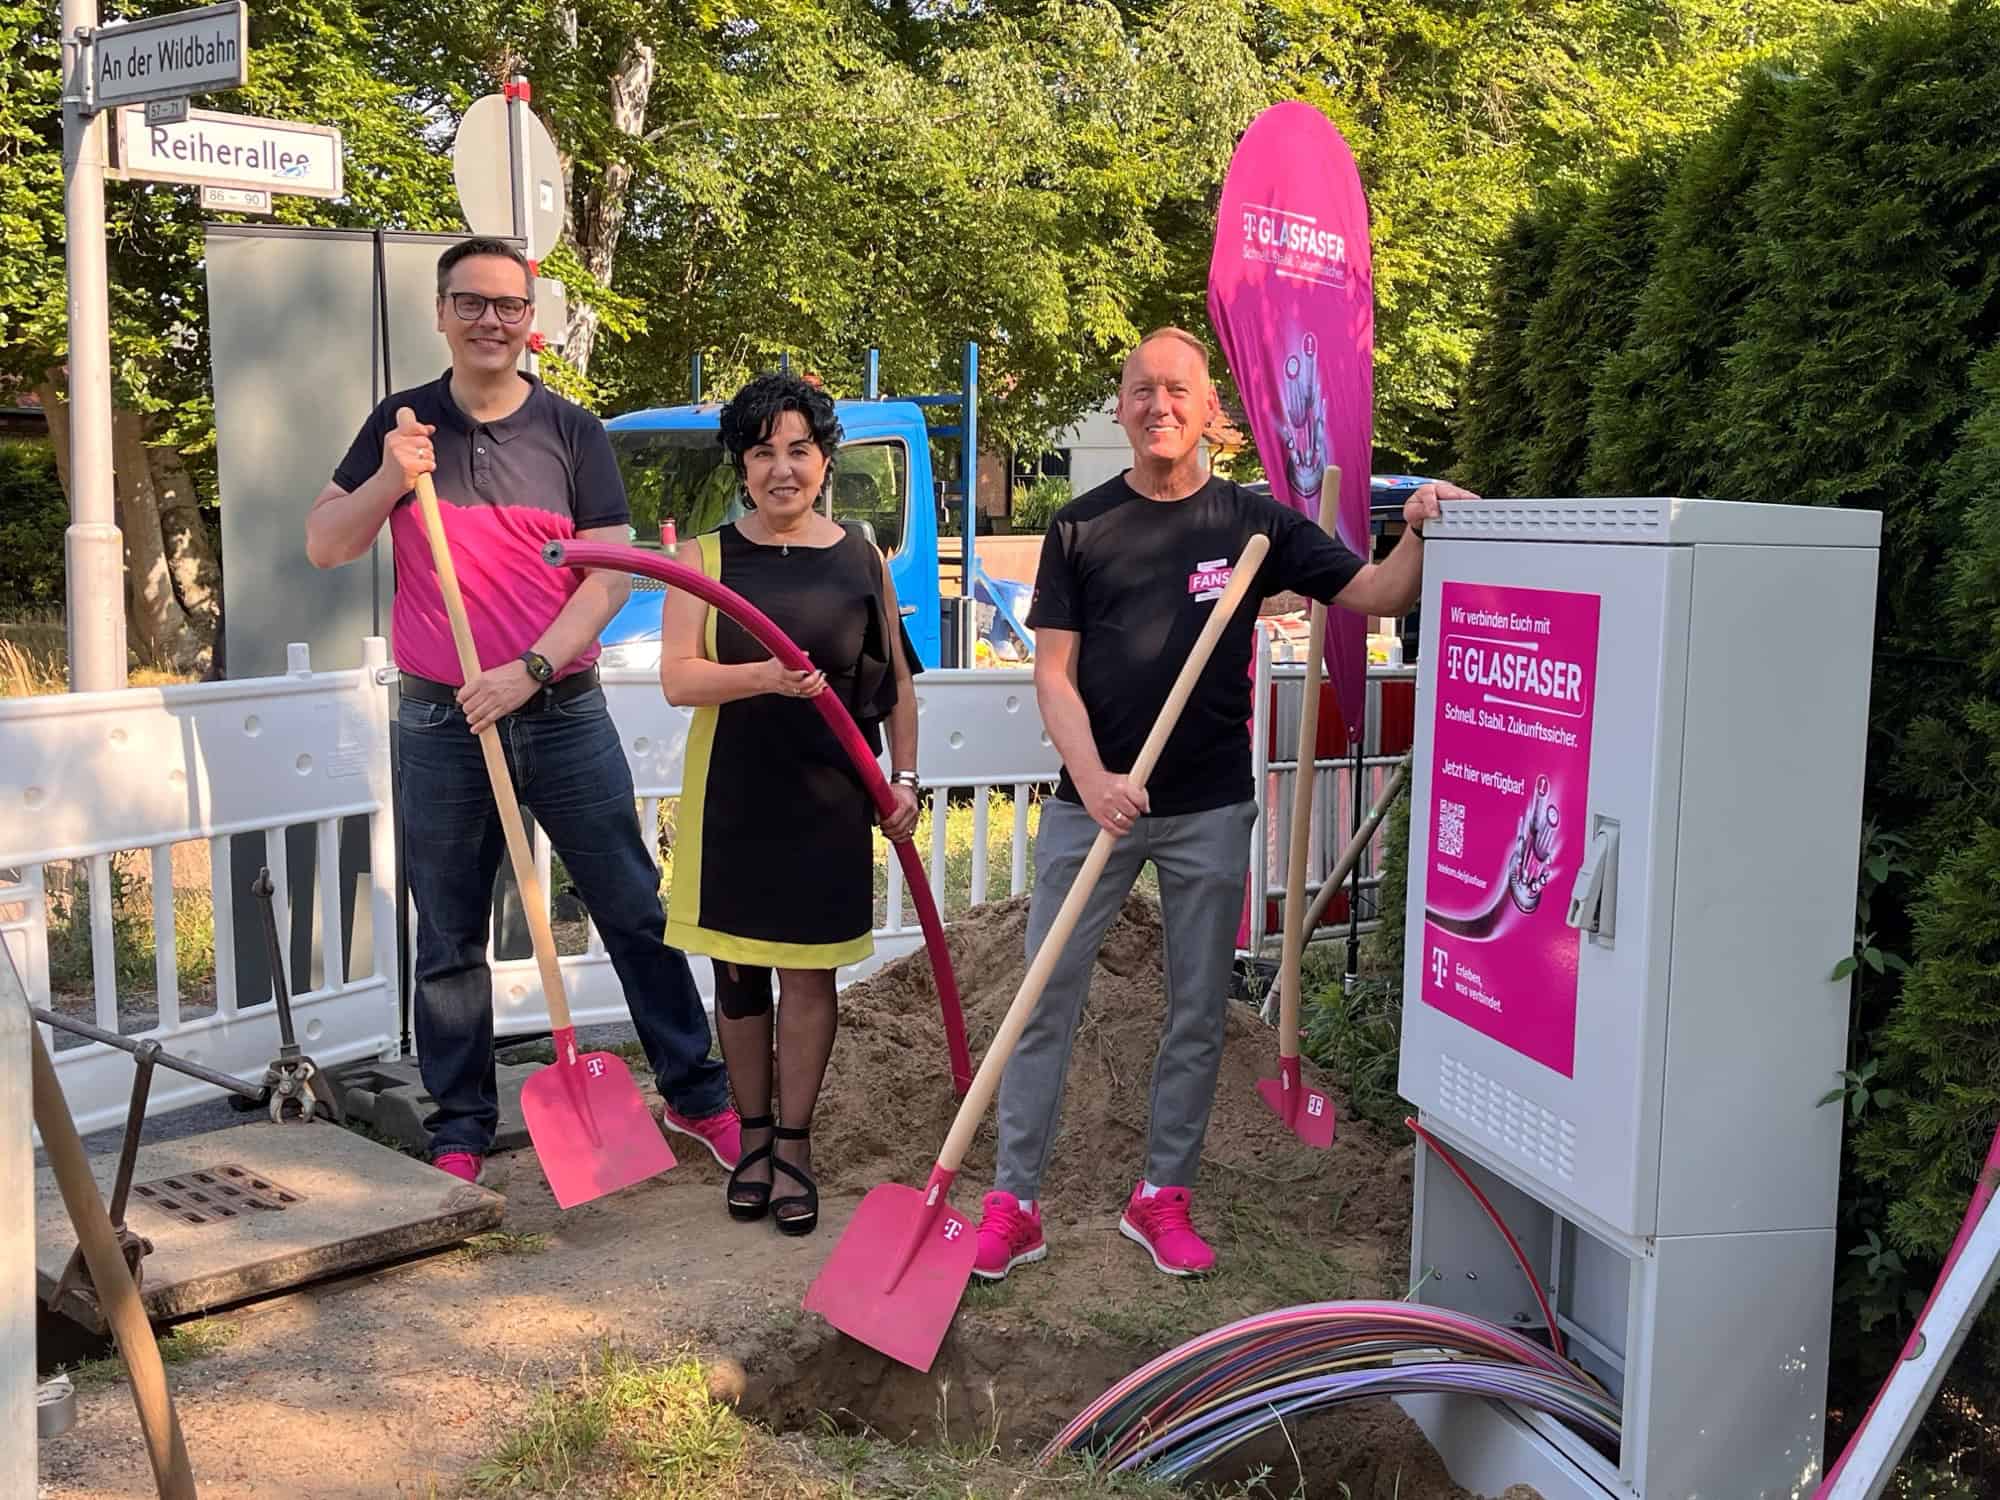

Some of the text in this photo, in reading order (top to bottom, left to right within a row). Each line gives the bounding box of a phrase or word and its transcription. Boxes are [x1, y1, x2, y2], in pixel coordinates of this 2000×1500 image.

[101, 31, 236, 81] An der Wildbahn
[151, 126, 310, 170] Reiherallee
[209, 190, 225, 202] 86
[244, 193, 260, 205] 90
[1258, 215, 1345, 262] GLASFASER
[1192, 571, 1230, 589] FANS
[1451, 607, 1551, 634] Wir verbinden Euch mit
[1463, 647, 1583, 703] GLASFASER
[1444, 703, 1579, 749] Schnell. Stabil. Zukunftssicher.
[1442, 758, 1526, 796] Jetzt hier verfügbar!
[1455, 982, 1468, 997] was
